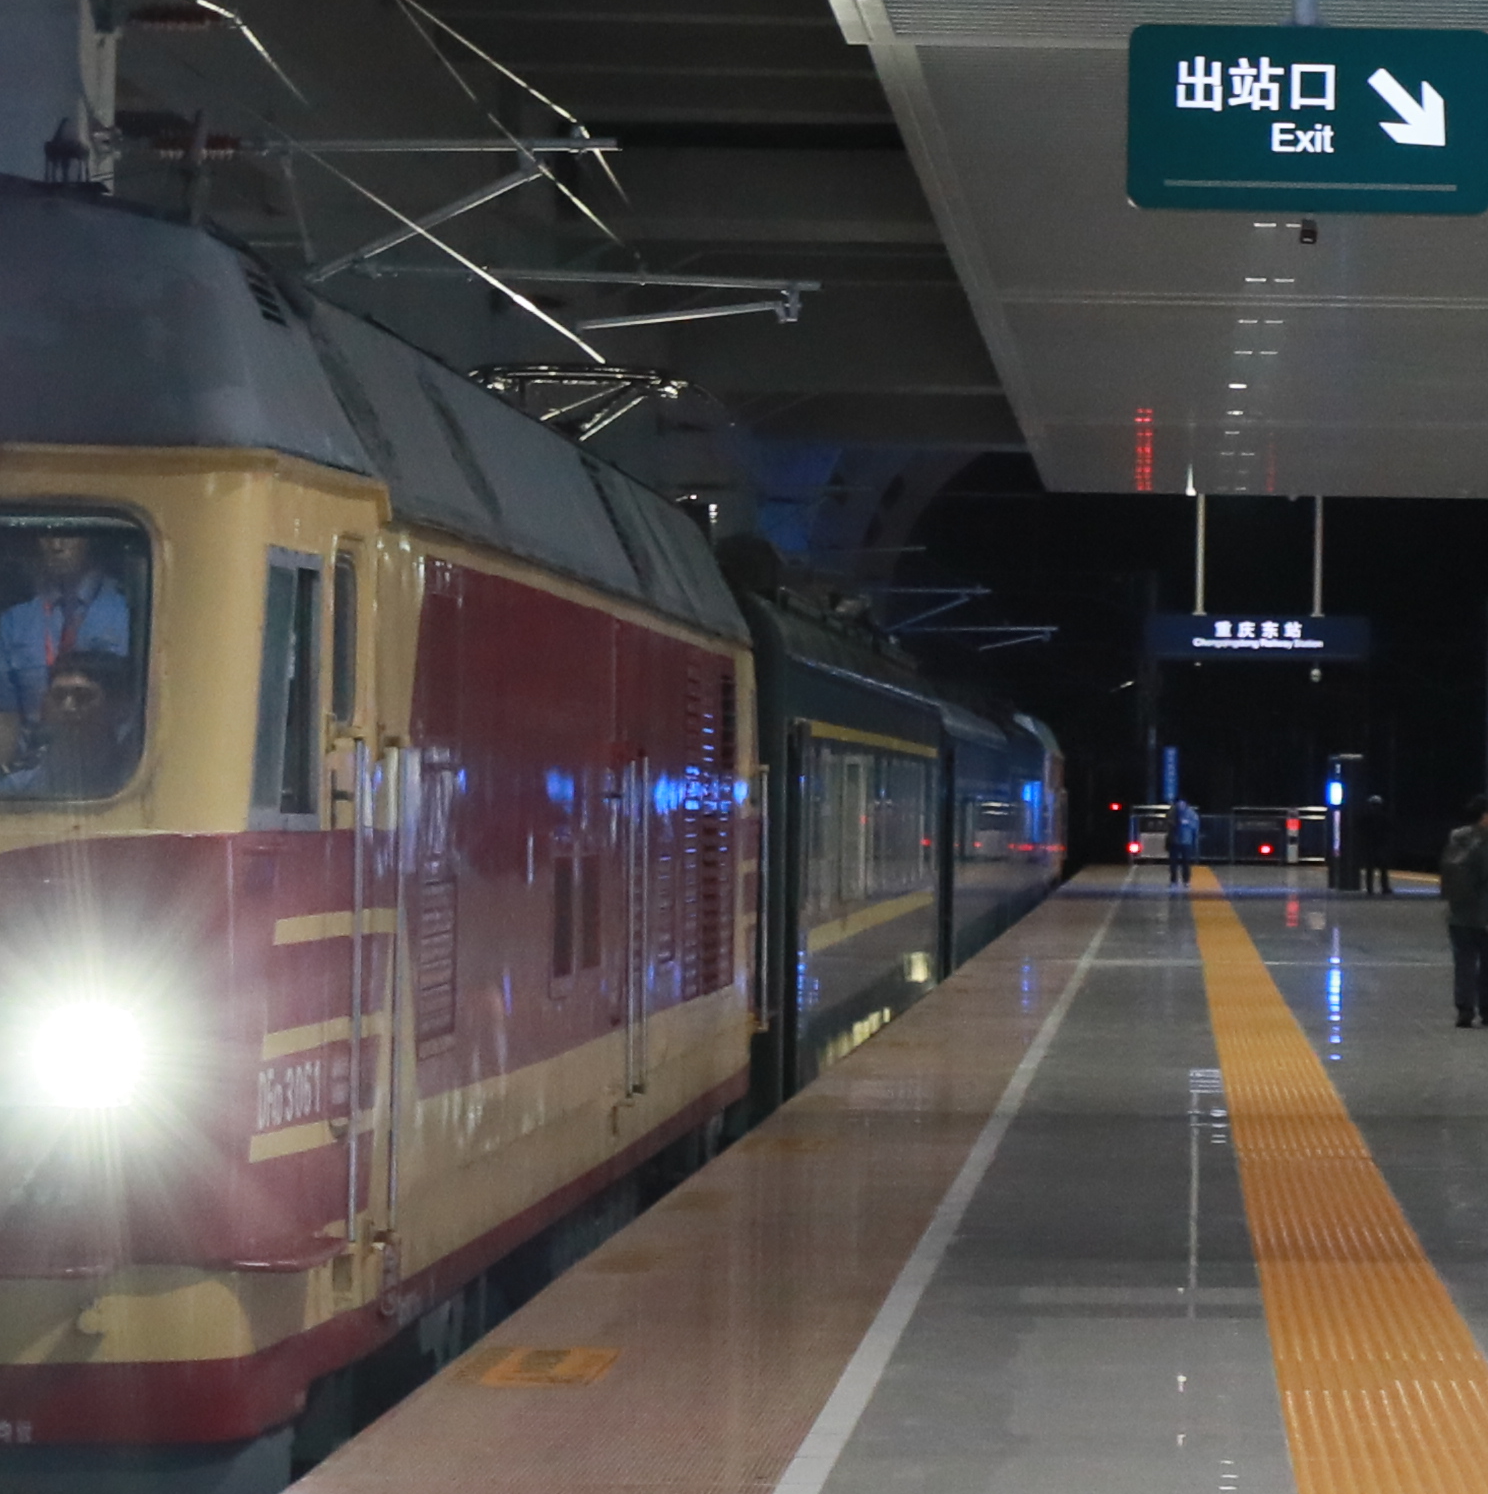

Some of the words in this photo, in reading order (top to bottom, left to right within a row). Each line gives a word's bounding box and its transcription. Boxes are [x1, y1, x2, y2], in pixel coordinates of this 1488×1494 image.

[1176, 55, 1336, 112] 出站口
[1271, 122, 1335, 154] Exit
[1214, 620, 1303, 638] 重庆东站
